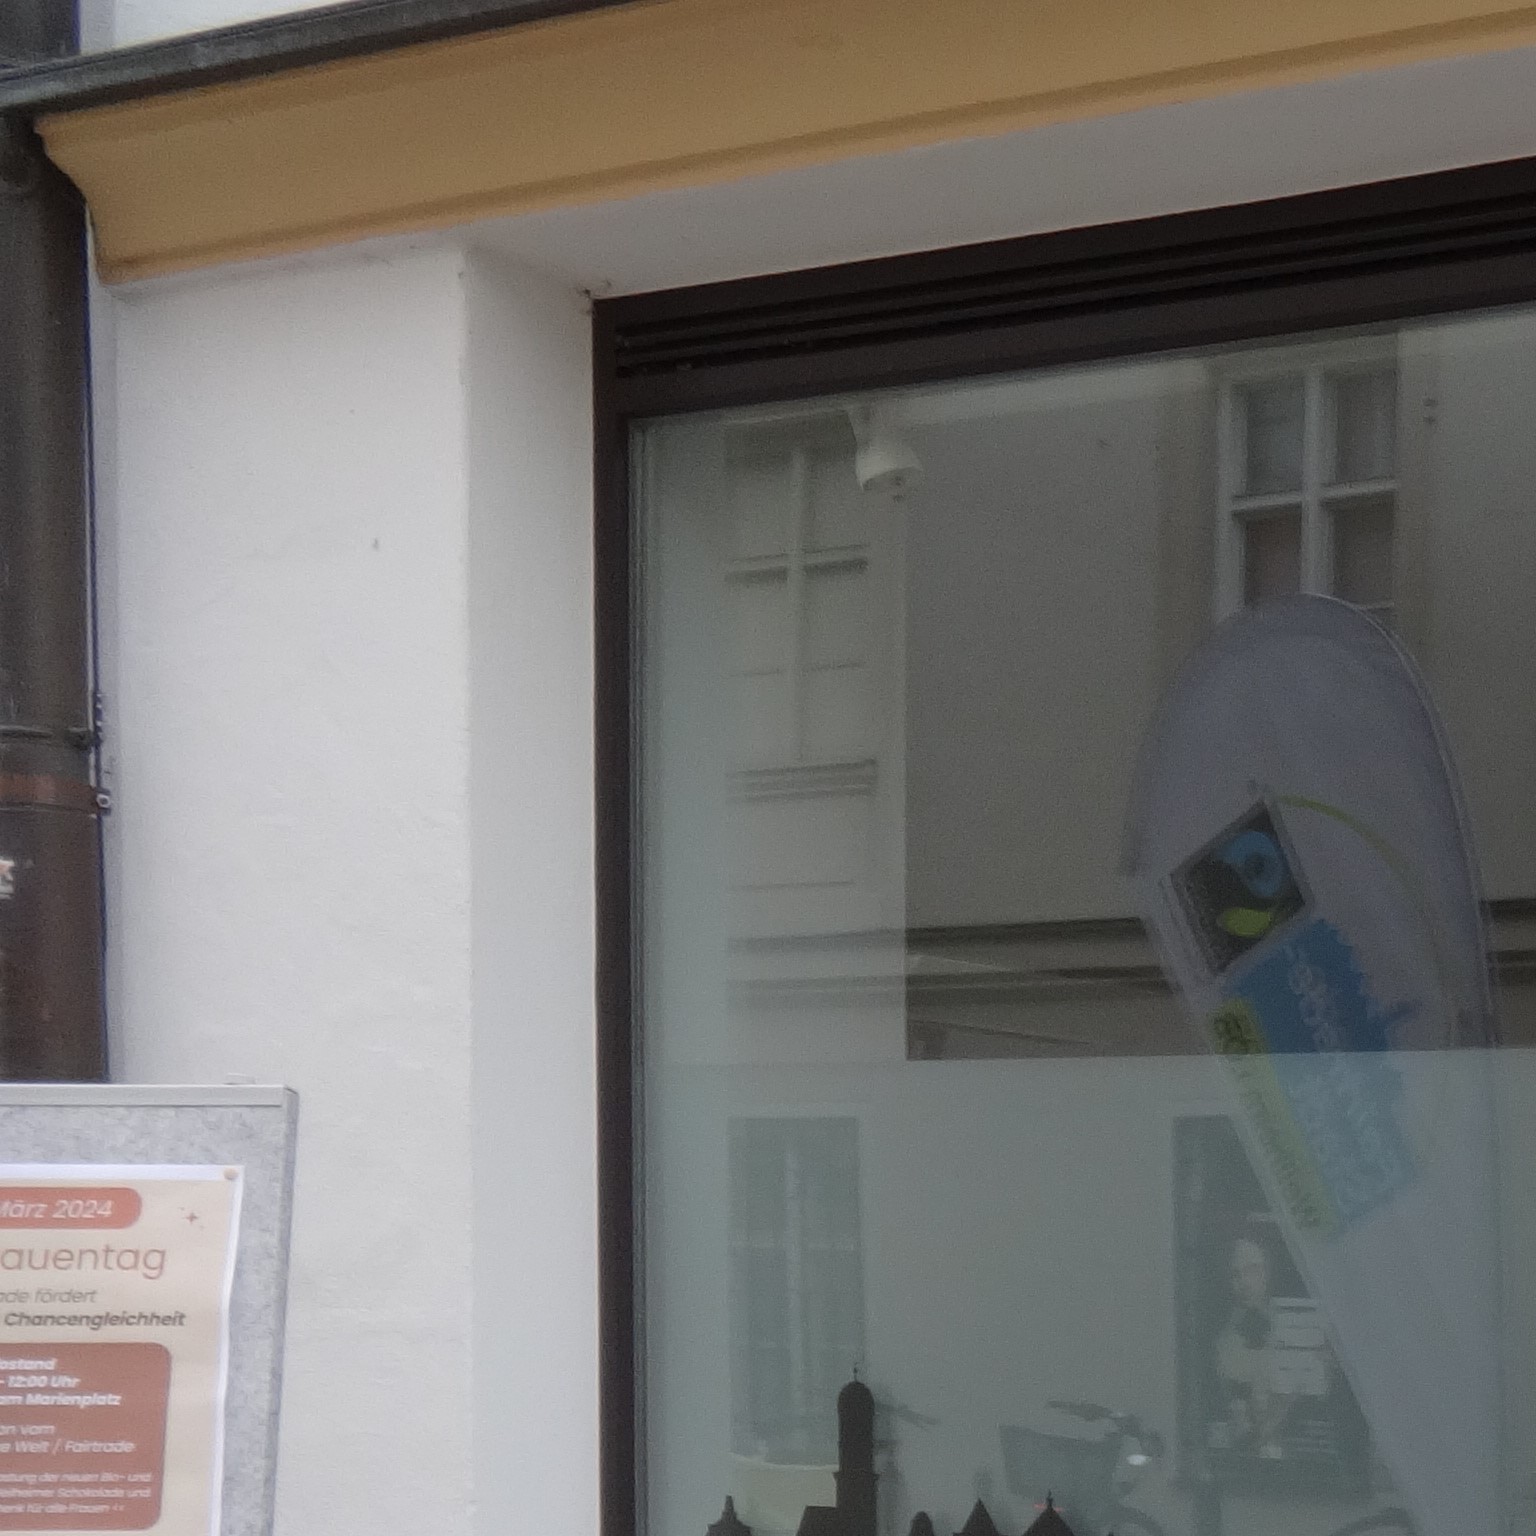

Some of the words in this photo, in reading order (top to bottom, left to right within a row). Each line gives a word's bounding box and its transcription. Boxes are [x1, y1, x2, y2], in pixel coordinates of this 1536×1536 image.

[53, 1199, 115, 1218] 2024
[4, 1310, 187, 1331] Chancengleichheit
[26, 1393, 122, 1409] Marienplatz
[65, 1441, 137, 1453] Fairtrade
